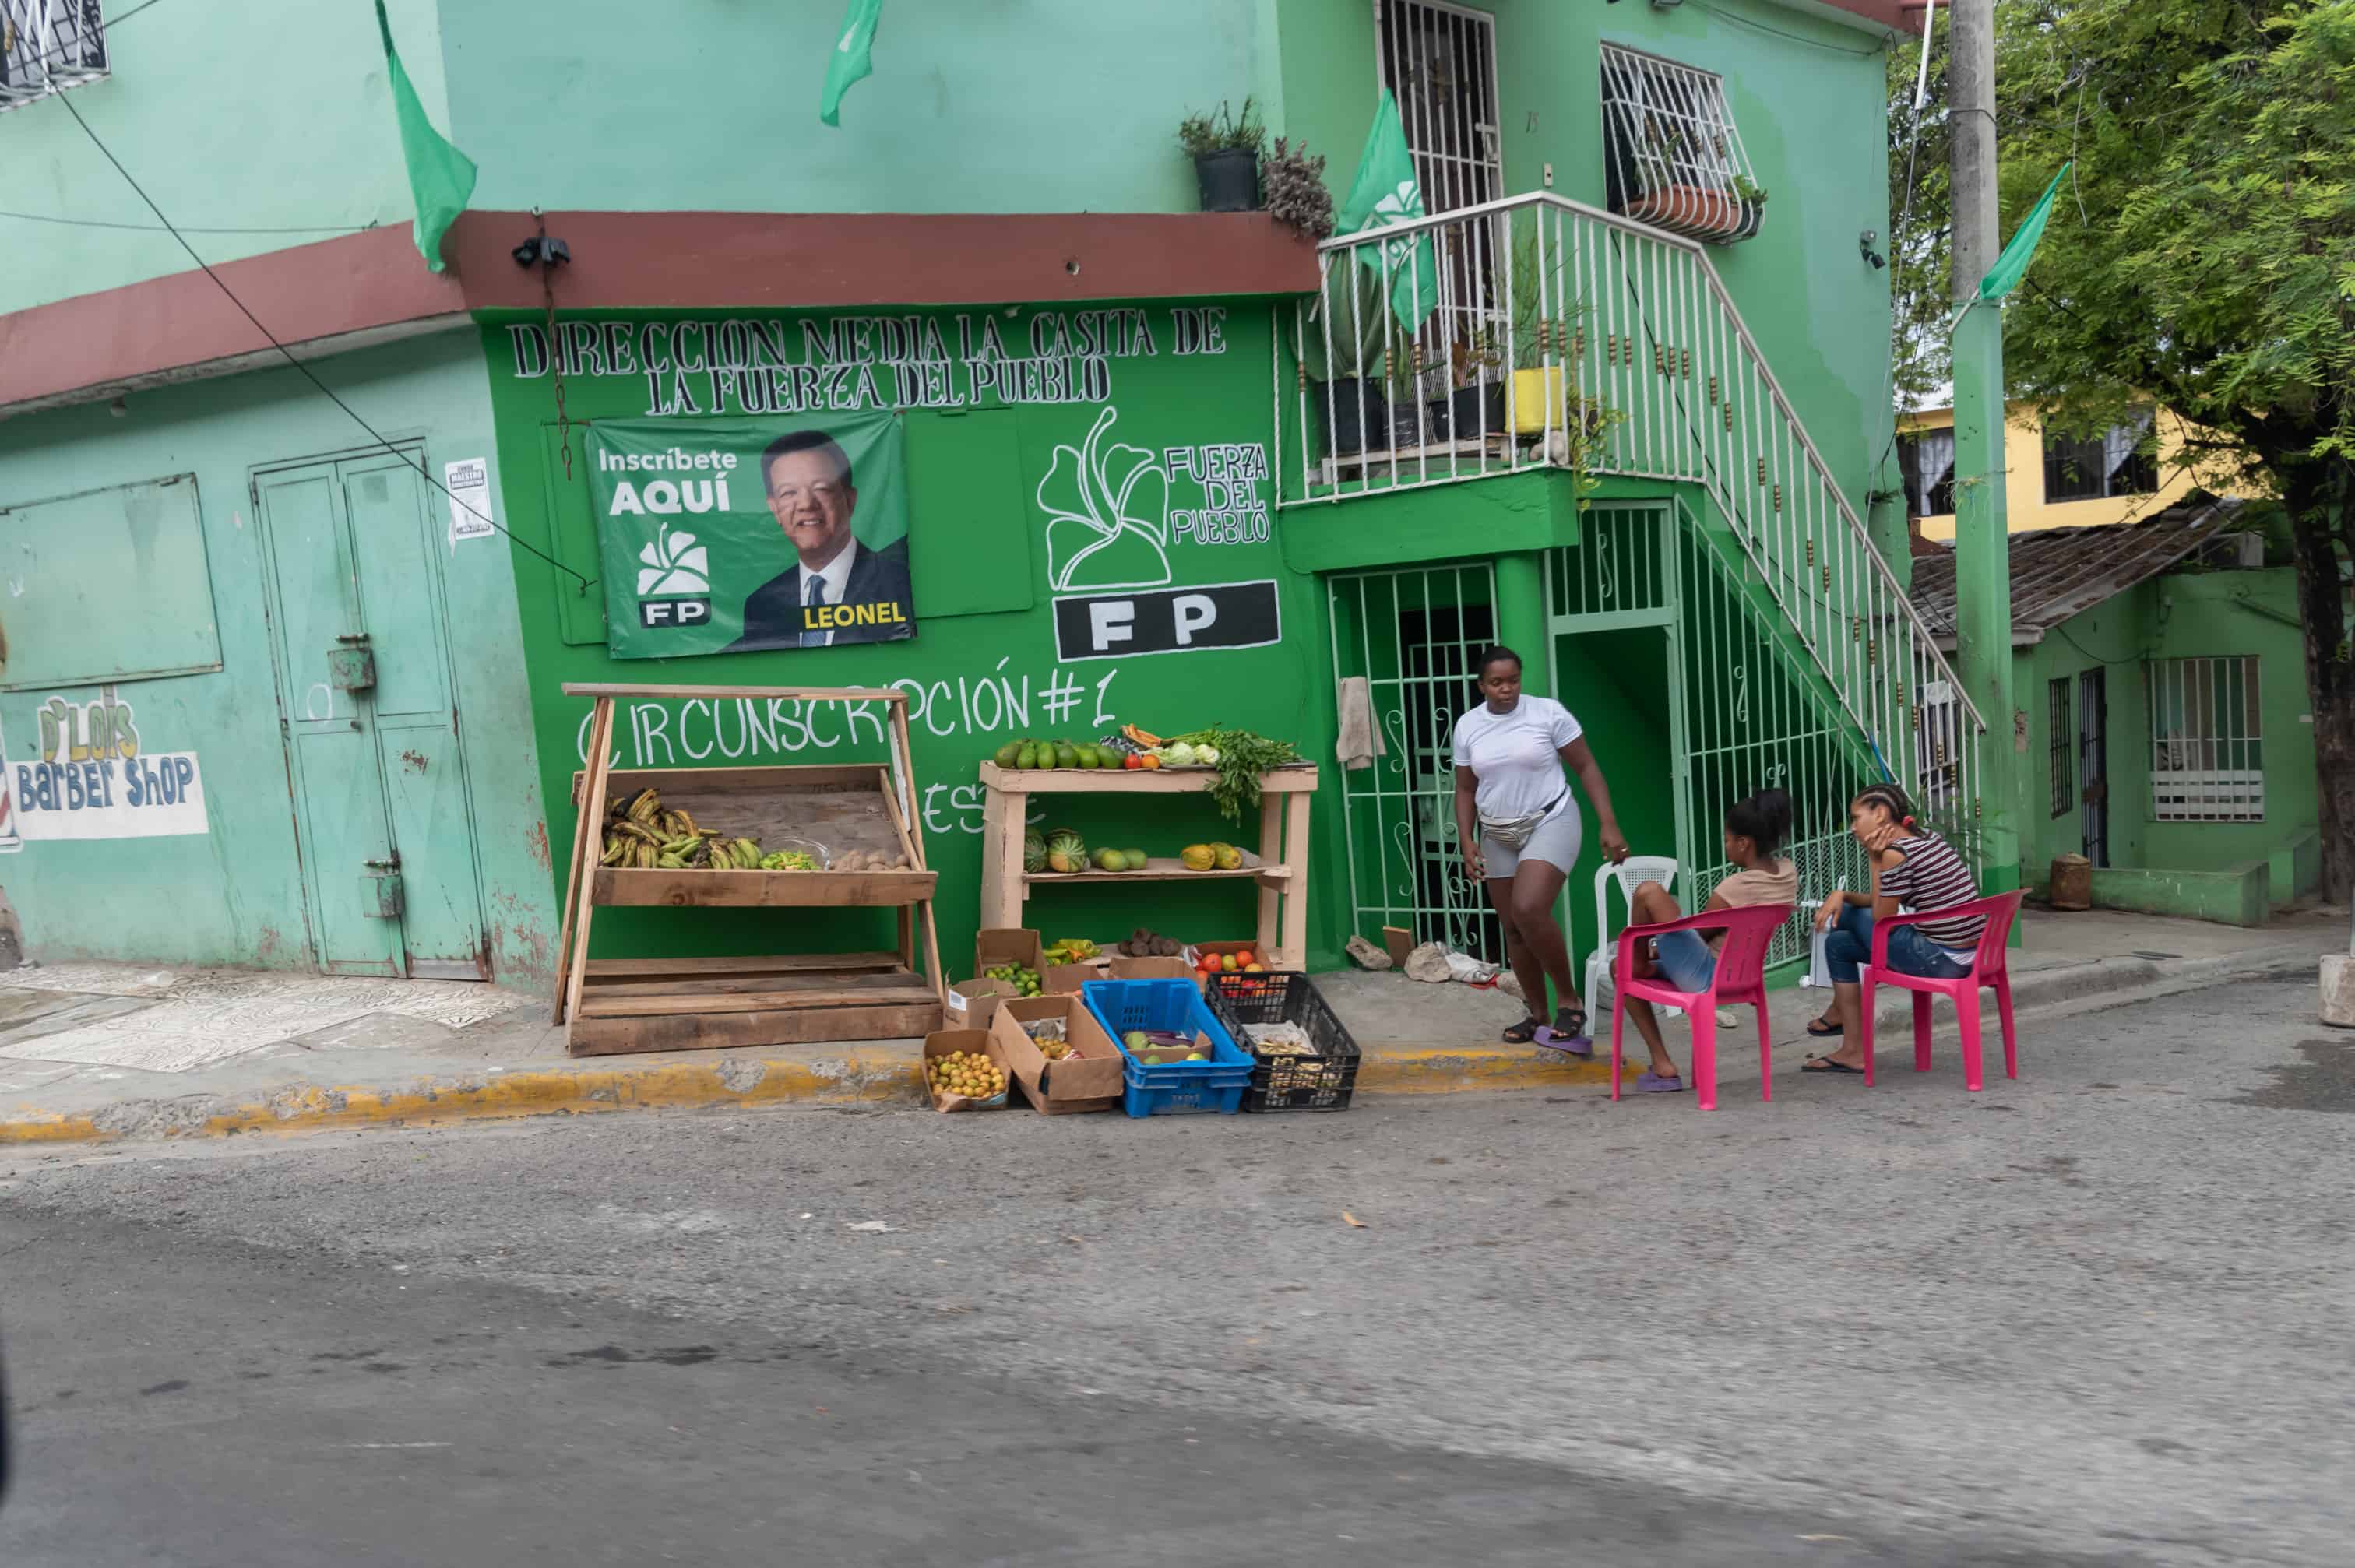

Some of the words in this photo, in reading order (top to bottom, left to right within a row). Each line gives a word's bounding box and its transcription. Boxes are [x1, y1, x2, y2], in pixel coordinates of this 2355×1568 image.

[505, 319, 788, 378] DIRECCION
[798, 315, 950, 366] MEDIA
[956, 314, 1010, 361] LA
[1030, 309, 1158, 358] CASITA
[1170, 307, 1227, 355] DE
[646, 367, 702, 416] LA
[710, 364, 886, 413] FUERZA
[891, 360, 965, 410] DEL
[966, 356, 1111, 405] PUEBLO
[598, 447, 737, 472] Inscríbete
[1163, 443, 1269, 483] FUERZA
[609, 471, 730, 516] AQUÍ
[1203, 479, 1266, 512] DEL
[1170, 509, 1270, 544] PUEBLO
[646, 601, 705, 625] FP
[804, 602, 906, 629] LEONEL
